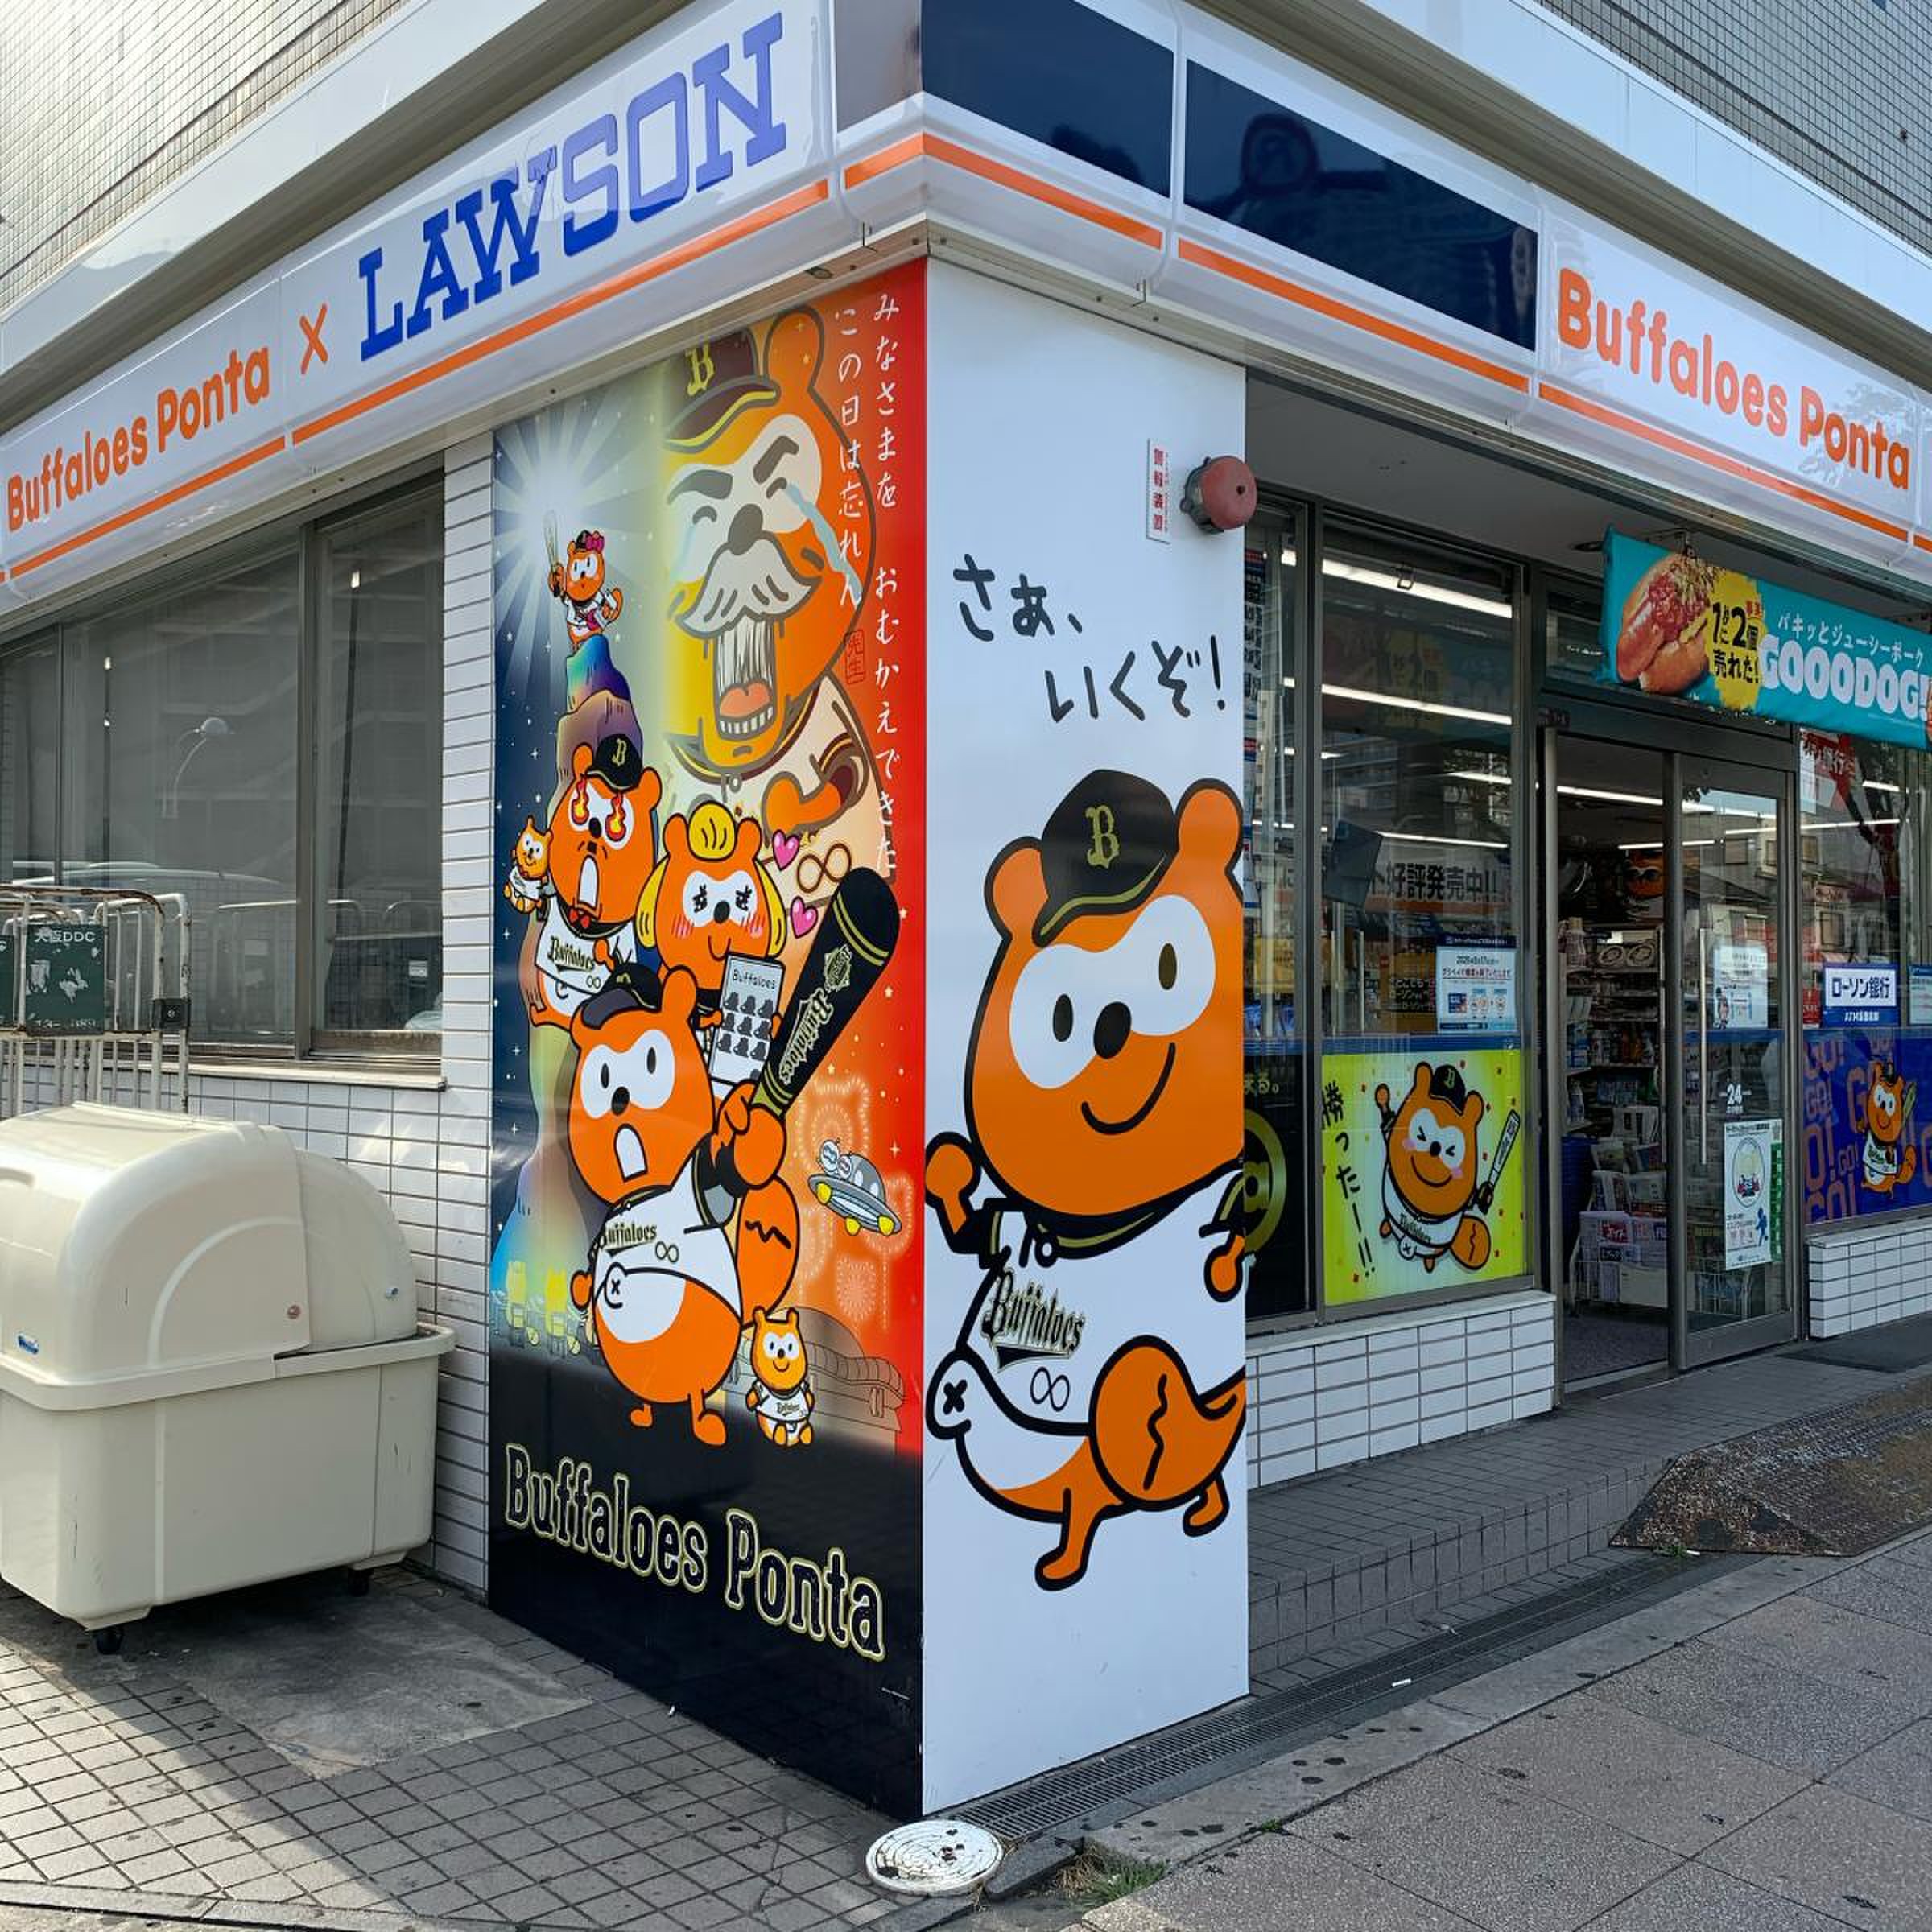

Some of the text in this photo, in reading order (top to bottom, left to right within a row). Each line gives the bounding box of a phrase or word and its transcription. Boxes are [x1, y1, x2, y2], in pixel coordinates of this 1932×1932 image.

[6, 417, 148, 532] Buffaloes
[158, 345, 270, 453] Ponta
[359, 12, 786, 361] LAWSON
[875, 293, 900, 508] みなさまを
[1558, 267, 1909, 490] Buffaloes Ponta
[1045, 634, 1225, 722] いくぞ!
[1084, 805, 1120, 869] B
[1832, 976, 1890, 999] ローソン銀行
[979, 1266, 1086, 1354] Buffaloes
[506, 1443, 886, 1662] Buffaloes Ponta
